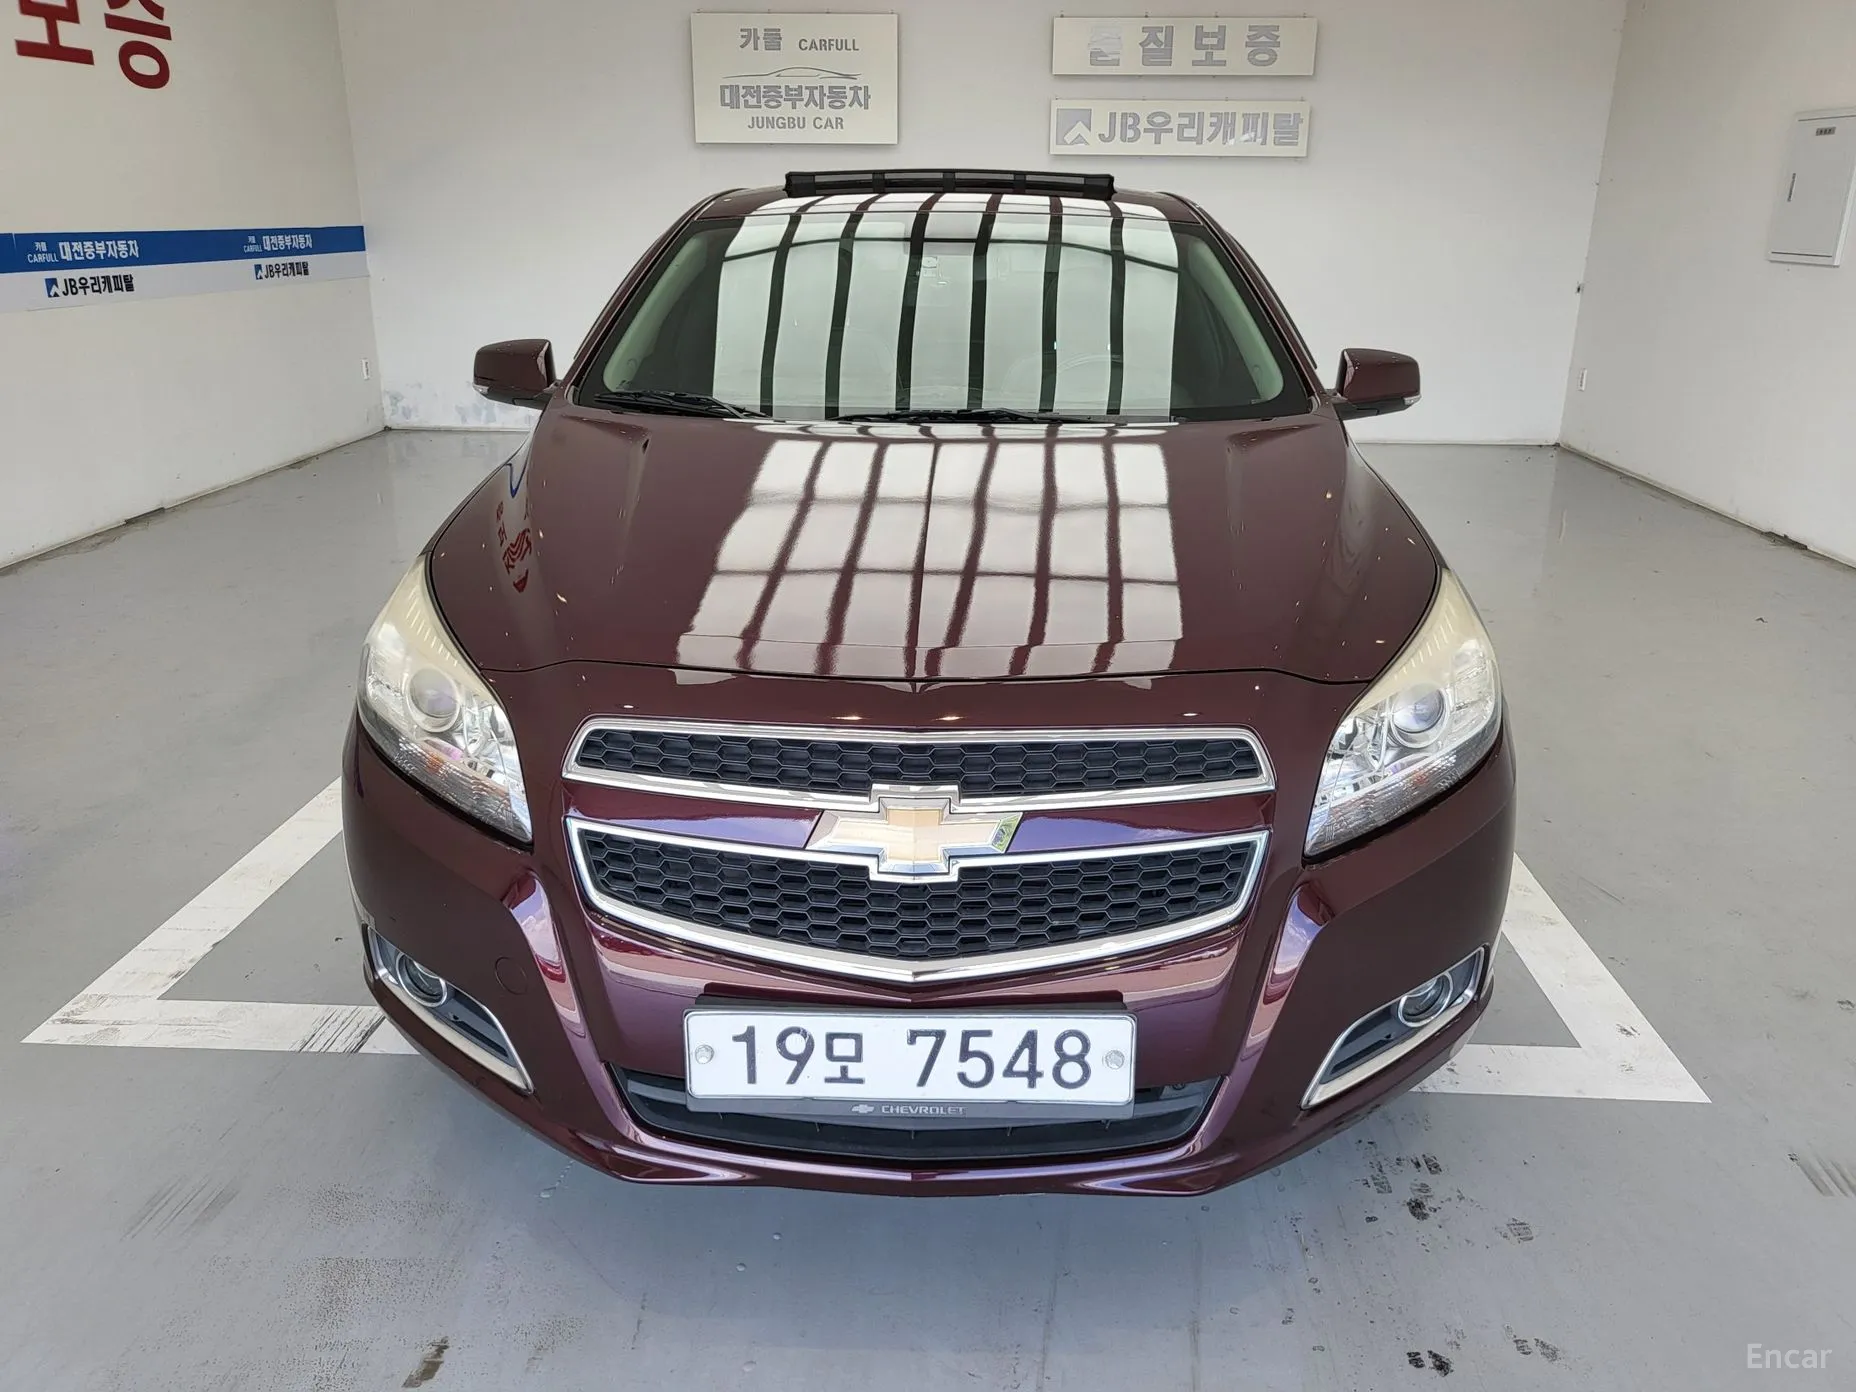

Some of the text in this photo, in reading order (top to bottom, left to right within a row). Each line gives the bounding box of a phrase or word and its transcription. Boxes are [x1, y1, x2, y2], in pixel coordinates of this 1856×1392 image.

[798, 38, 860, 52] CARFULL
[719, 84, 871, 110] 대전중부자동차
[747, 116, 844, 130] JUNGBU CAR
[1098, 110, 1304, 146] JB우리캐피탈
[27, 240, 139, 263] CARFULL 대전중부자동차
[263, 234, 313, 251] 대전중부자동차
[264, 261, 309, 279] JB우리캐피탈
[62, 274, 134, 296] JB우리캐피탈
[731, 1025, 1092, 1090] 19모 7548
[881, 1104, 968, 1115] CHEVROLET
